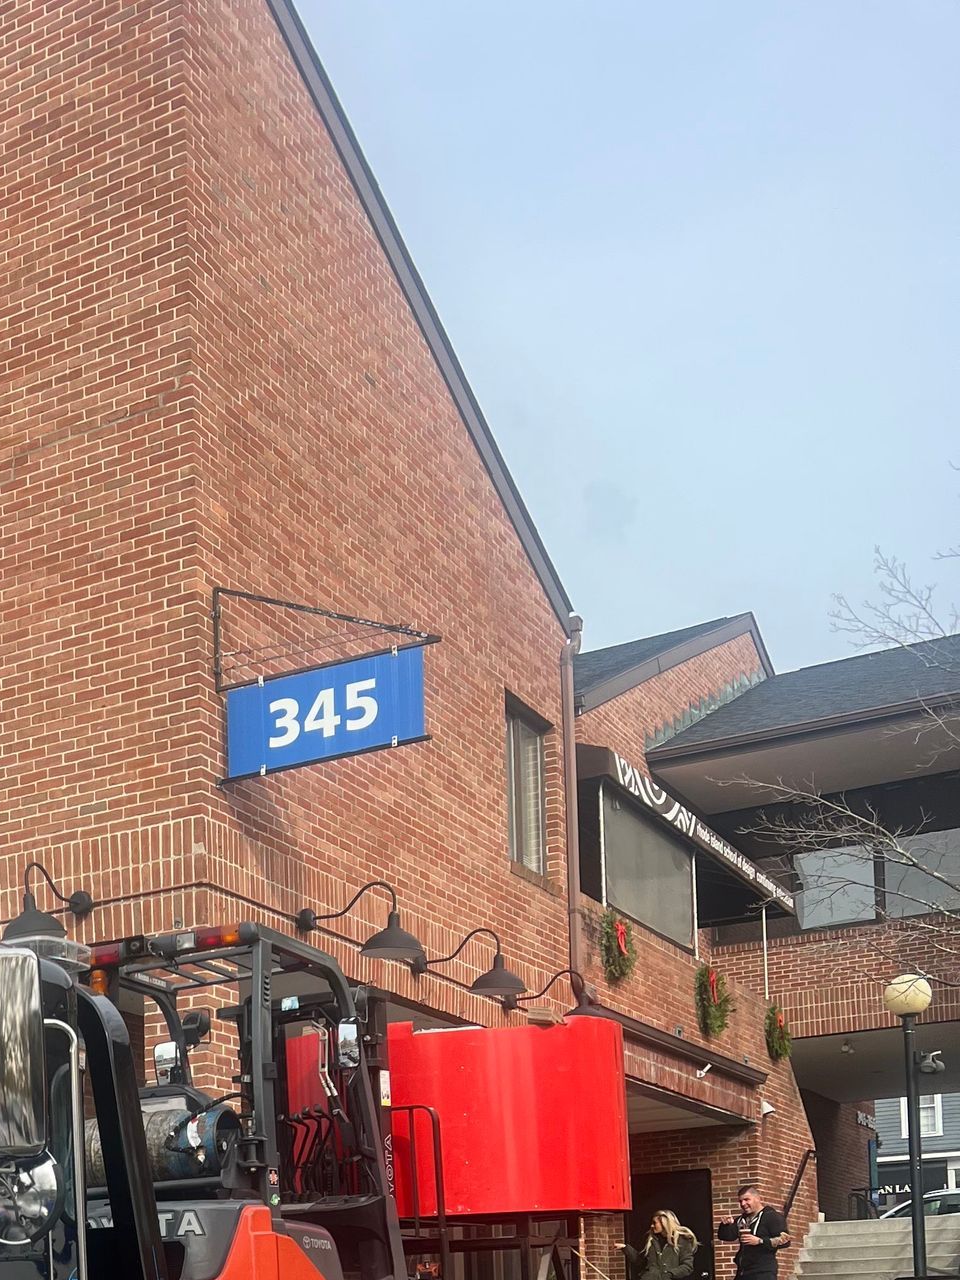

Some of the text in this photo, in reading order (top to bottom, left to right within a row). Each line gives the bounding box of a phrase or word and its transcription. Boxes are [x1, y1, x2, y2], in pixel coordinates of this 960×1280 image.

[268, 677, 379, 748] 345
[384, 1133, 395, 1198] YOTA
[877, 1184, 912, 1195] AN LA
[310, 1238, 332, 1250] TOYOTA
